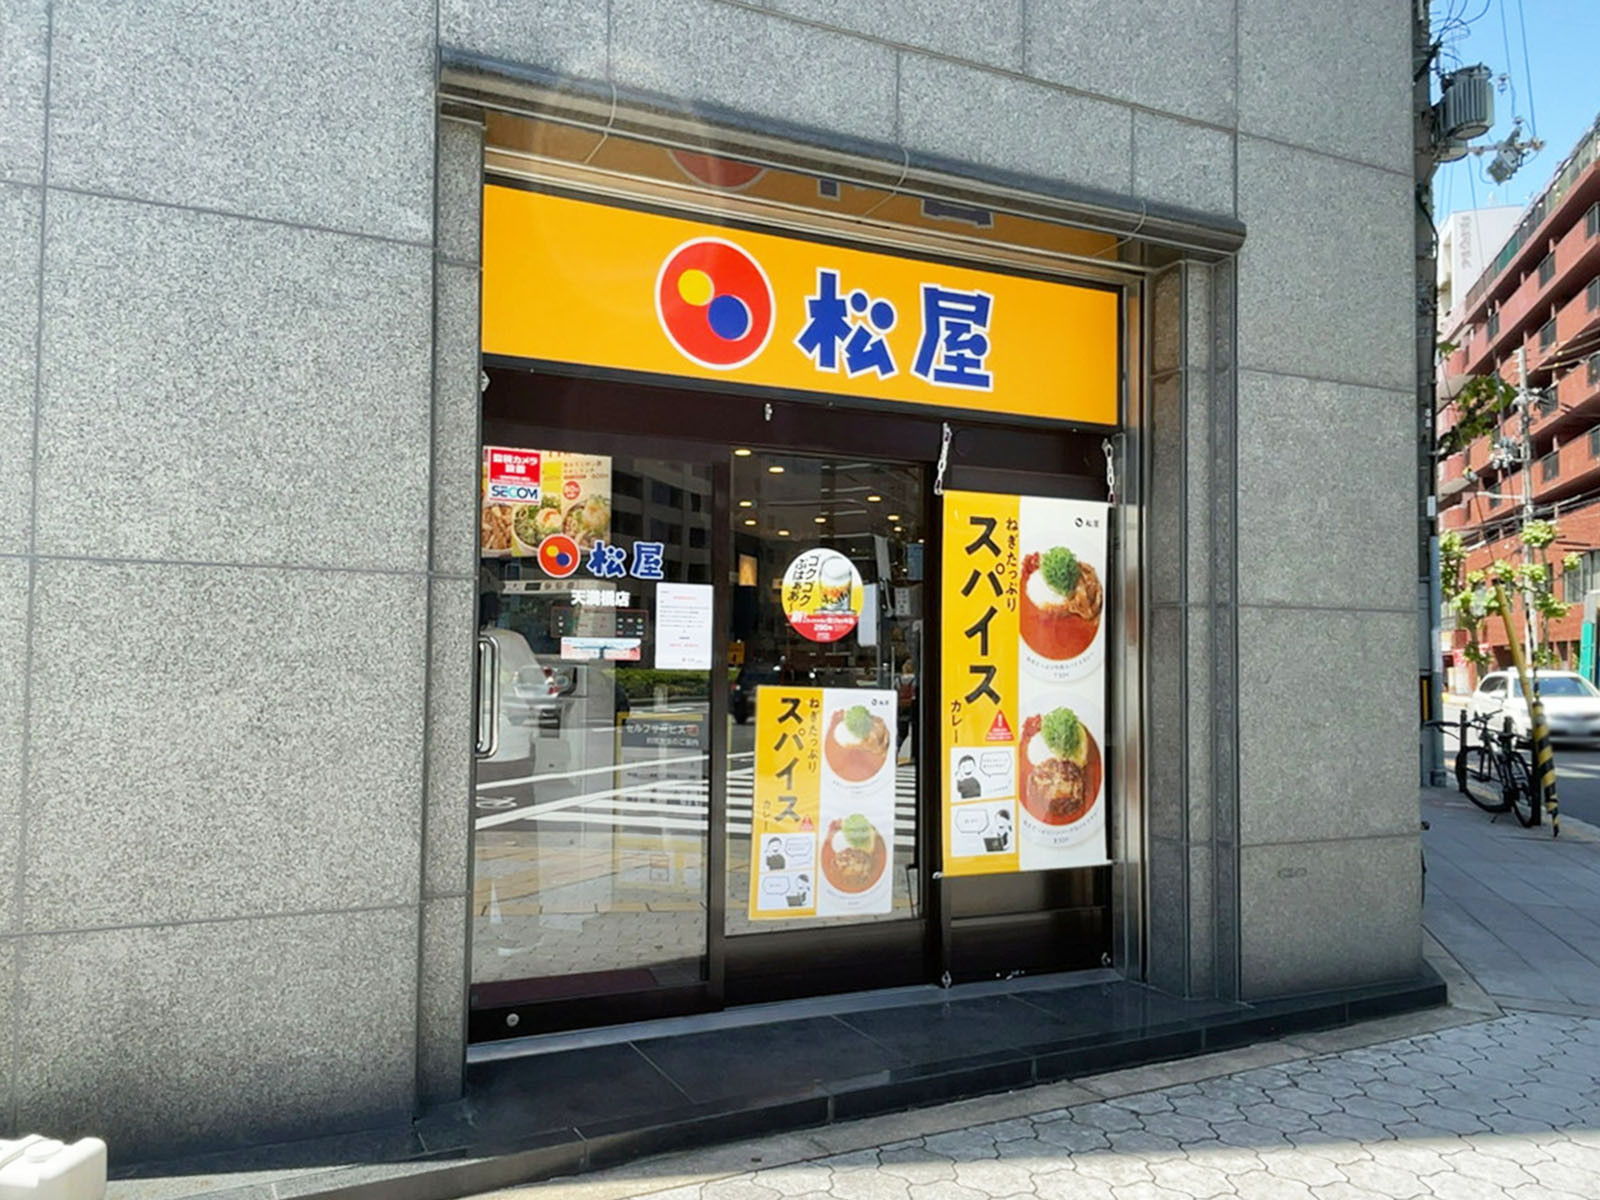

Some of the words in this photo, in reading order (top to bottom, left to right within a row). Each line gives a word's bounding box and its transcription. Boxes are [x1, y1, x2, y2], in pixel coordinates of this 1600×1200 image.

[794, 268, 994, 392] 松屋
[491, 485, 538, 500] SECOM
[586, 540, 664, 580] 松屋
[1005, 516, 1020, 612] ねぎたっぷり
[961, 515, 1003, 706] スパイス
[773, 697, 806, 822] スパイス
[807, 698, 821, 774] ねぎたっぷり
[950, 699, 963, 744] カレー
[763, 800, 772, 832] カレー
